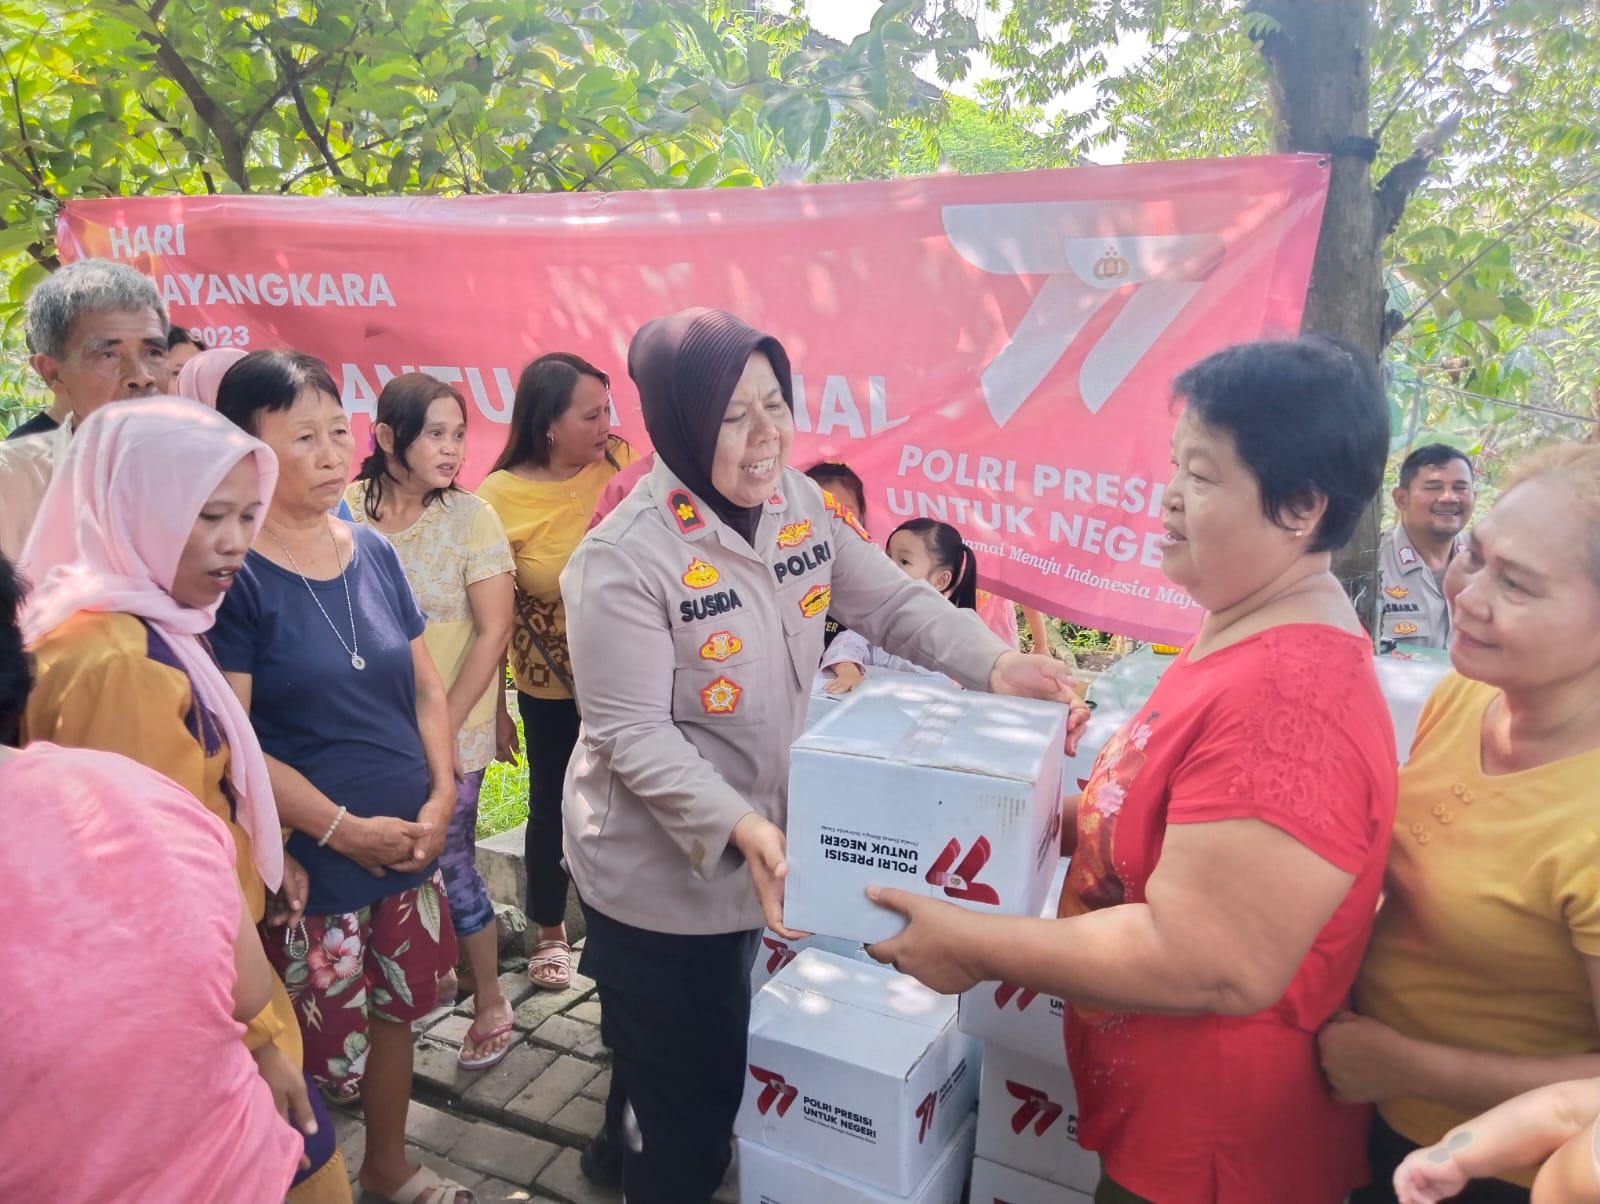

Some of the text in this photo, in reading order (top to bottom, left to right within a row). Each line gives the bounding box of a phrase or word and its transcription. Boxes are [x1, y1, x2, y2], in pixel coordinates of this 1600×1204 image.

[108, 223, 187, 259] HARI
[159, 272, 397, 307] AYANGKARA
[897, 444, 1166, 518] POLRI PRESI
[886, 487, 1163, 569] UNTUK NEGE
[773, 541, 832, 584] POLRI
[962, 537, 1006, 557] amai
[1009, 545, 1062, 576] Menuju
[1064, 563, 1151, 599] Indonesia
[680, 588, 742, 623] SUSIDA
[820, 834, 867, 852] NEGERI
[871, 843, 919, 860] UNTUK
[825, 848, 918, 875] POLRI PRESISI
[803, 1095, 873, 1127] POLRI PRESISI
[803, 1106, 838, 1126] UNTUK
[840, 1119, 877, 1139] NEGERI
